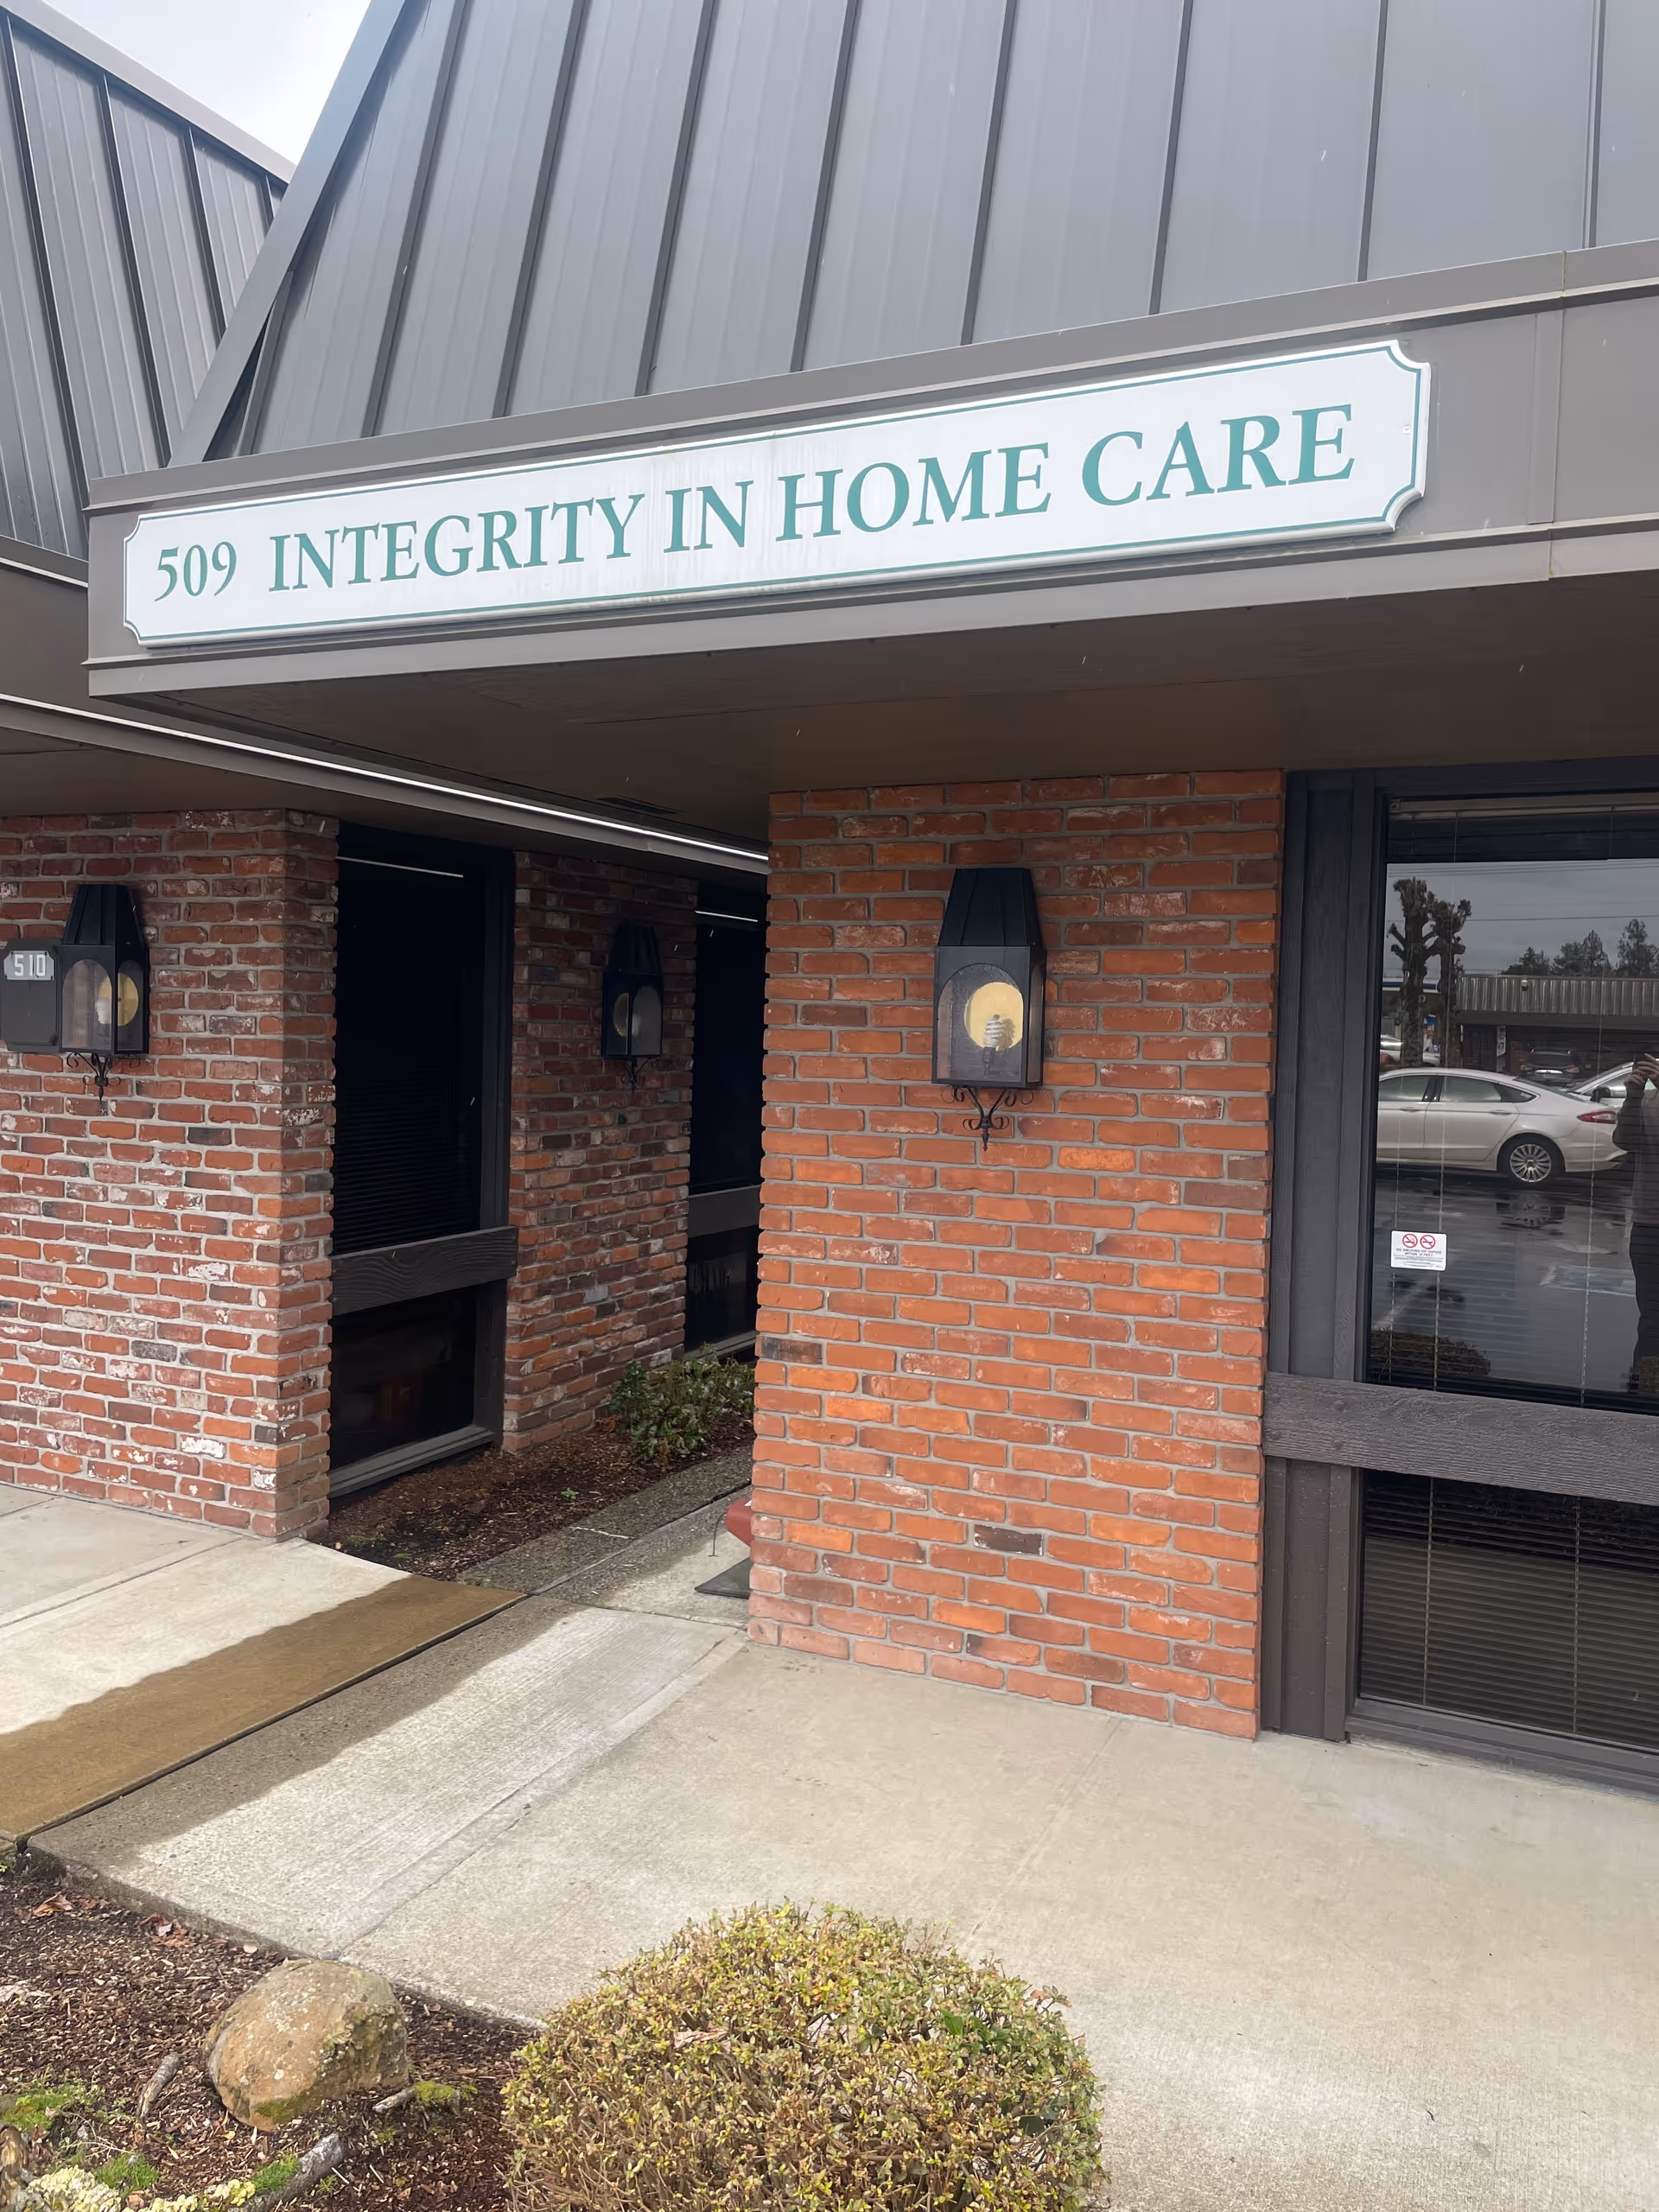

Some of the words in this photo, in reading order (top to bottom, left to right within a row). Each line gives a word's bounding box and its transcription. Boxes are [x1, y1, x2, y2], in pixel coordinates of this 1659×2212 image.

[154, 541, 238, 602] 509
[268, 493, 645, 593] INTEGRITY
[663, 480, 754, 554] IN
[775, 442, 1052, 542] HOME
[1081, 403, 1356, 506] CARE
[14, 953, 47, 977] 510
